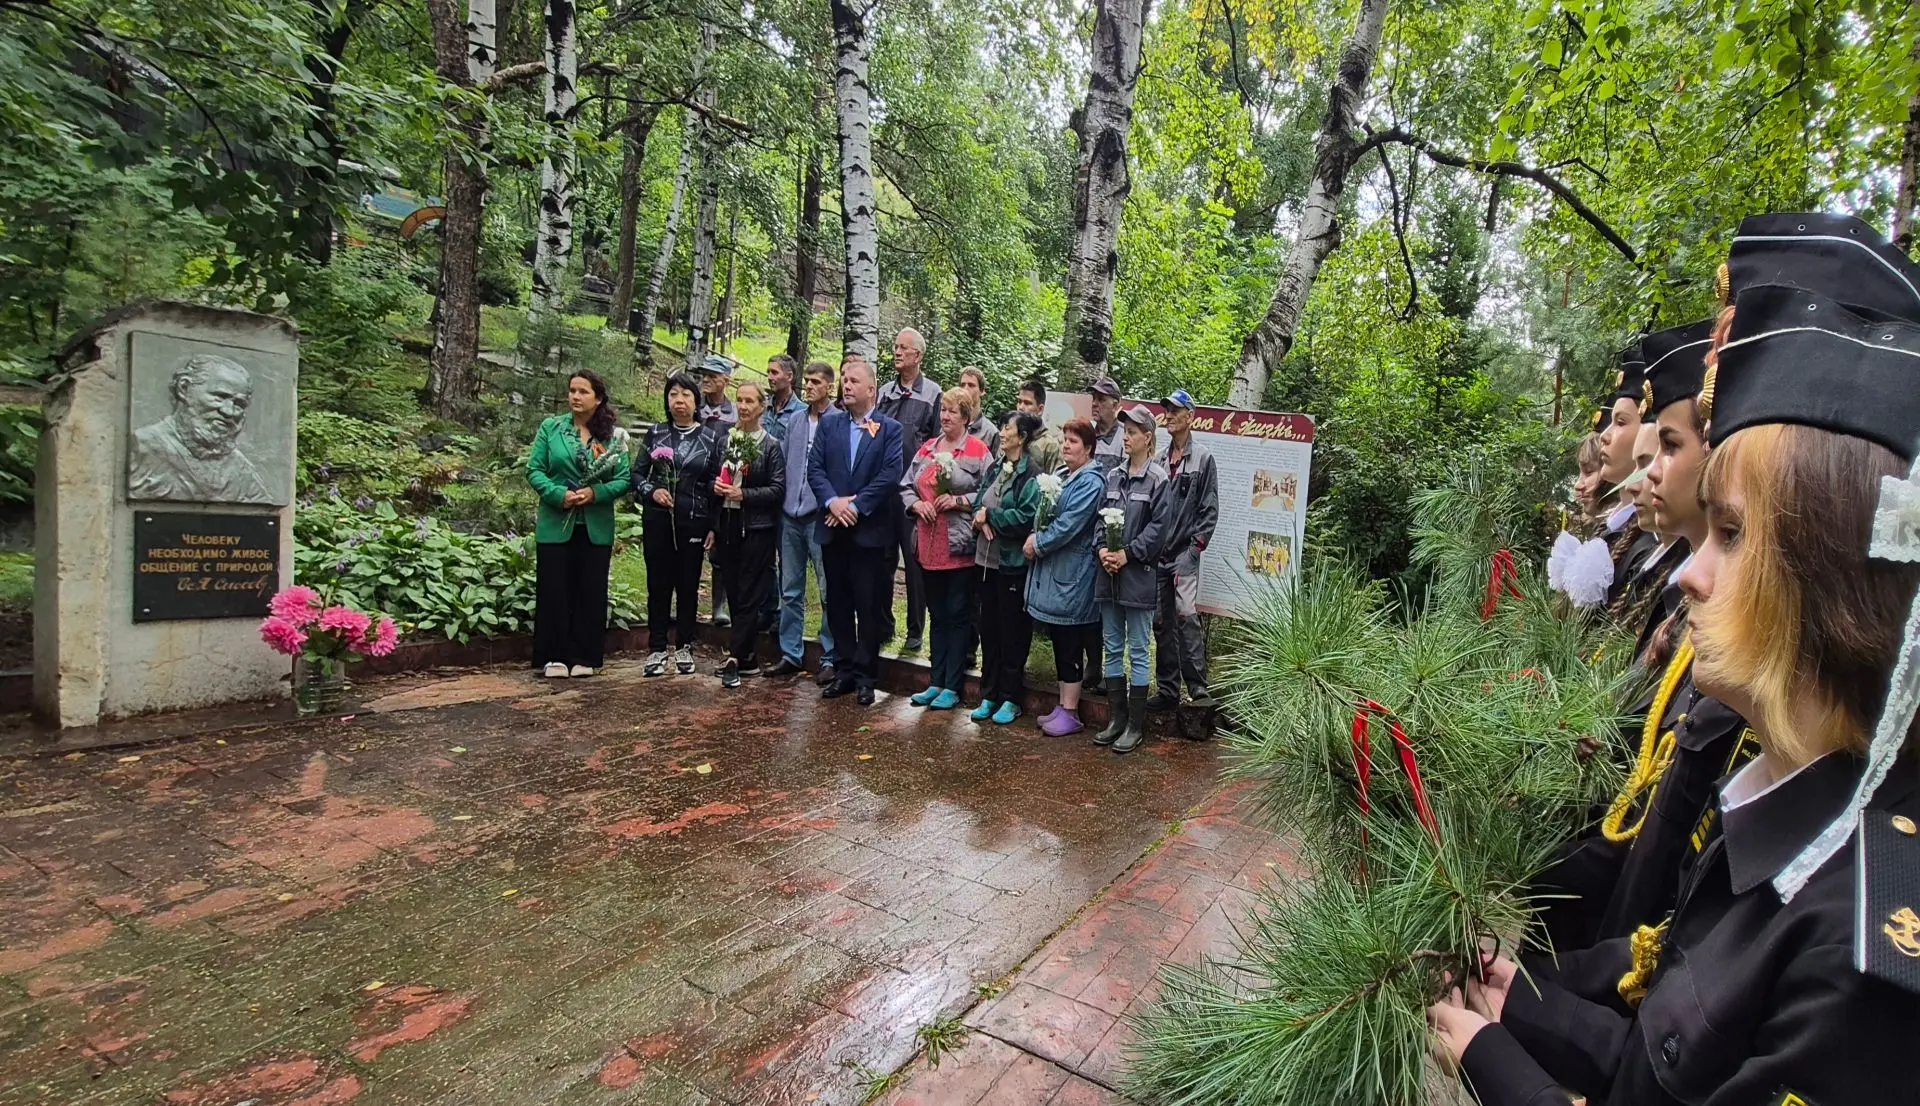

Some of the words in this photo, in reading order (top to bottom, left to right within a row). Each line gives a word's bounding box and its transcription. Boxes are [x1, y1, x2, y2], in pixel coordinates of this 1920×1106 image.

[148, 548, 227, 559] НЕОБХОДИМО
[231, 549, 270, 559] ЖИВОЕ
[140, 562, 199, 573] ОБЩЕНИЕ
[203, 563, 211, 572] С
